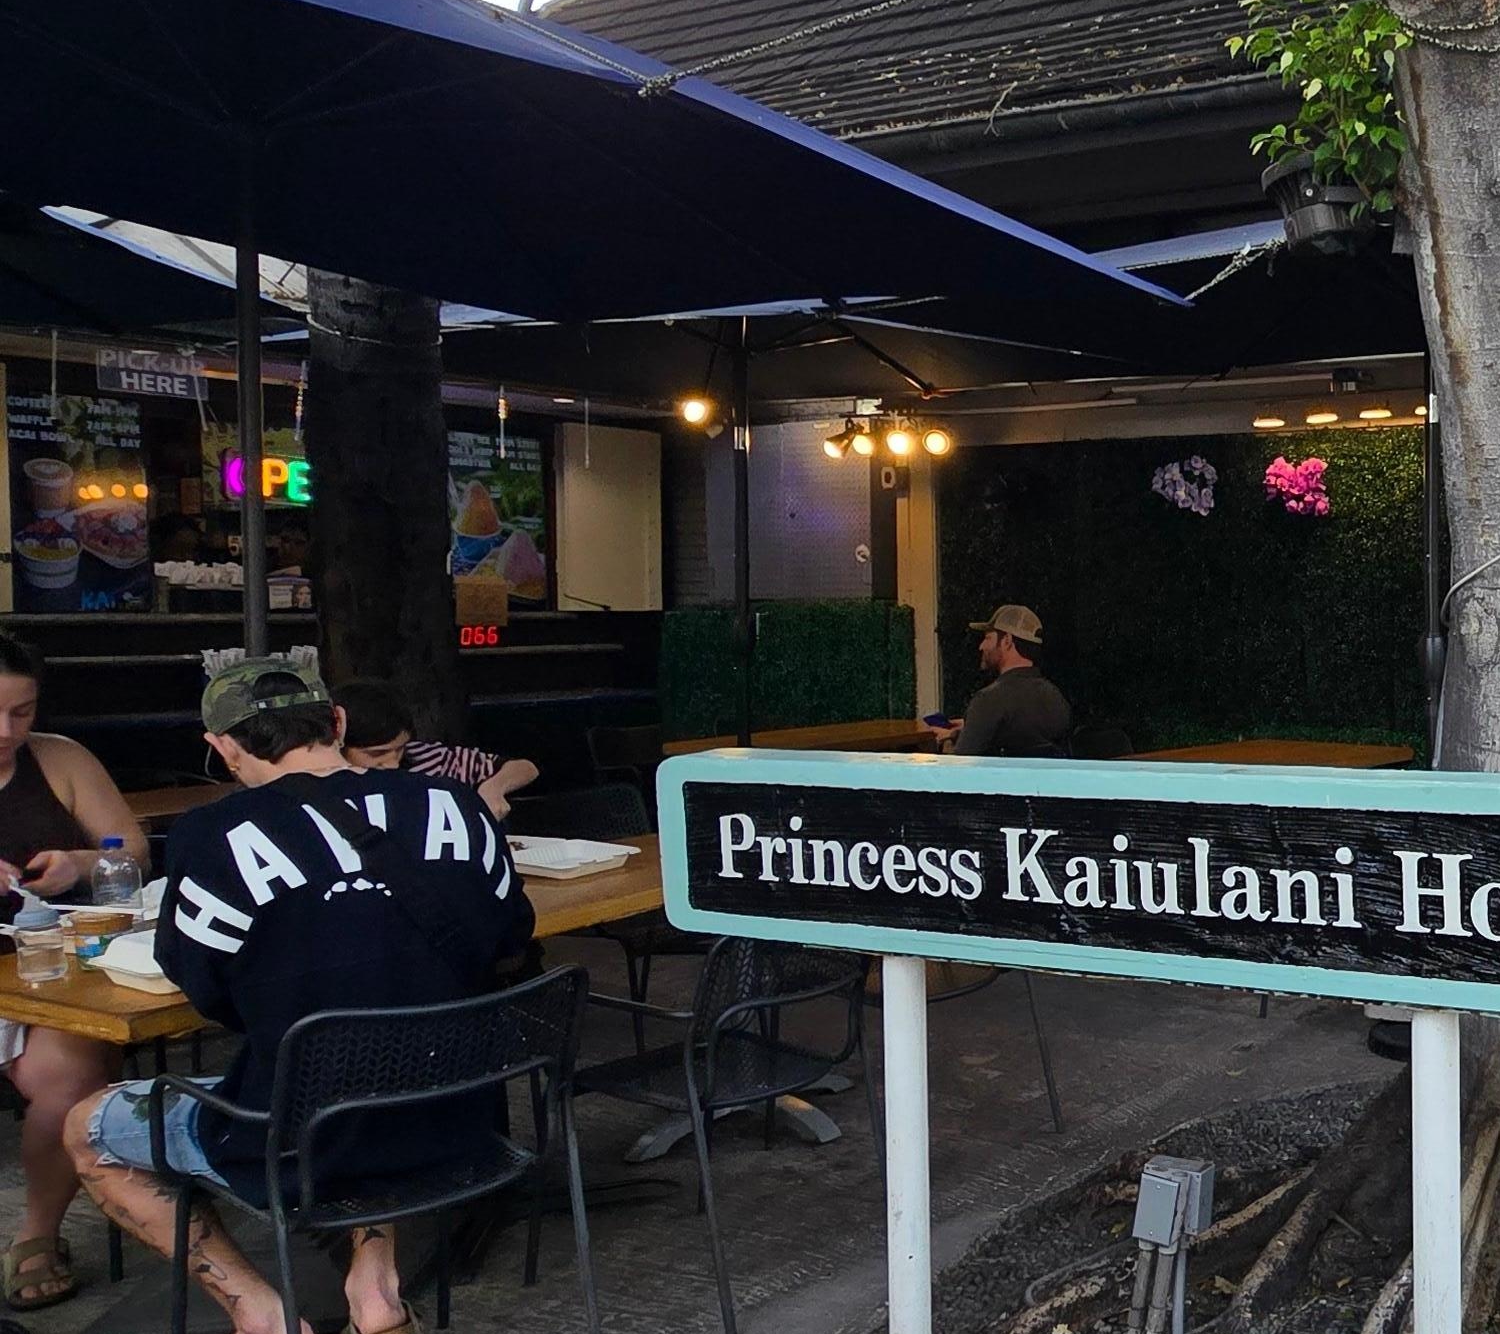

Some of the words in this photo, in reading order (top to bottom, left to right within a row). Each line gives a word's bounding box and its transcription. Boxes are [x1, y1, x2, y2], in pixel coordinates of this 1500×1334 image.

[120, 370, 188, 395] HERE
[121, 438, 141, 449] DAY
[460, 626, 498, 646] 066
[718, 813, 983, 900] Princess
[1000, 827, 1362, 928] Kaiulani
